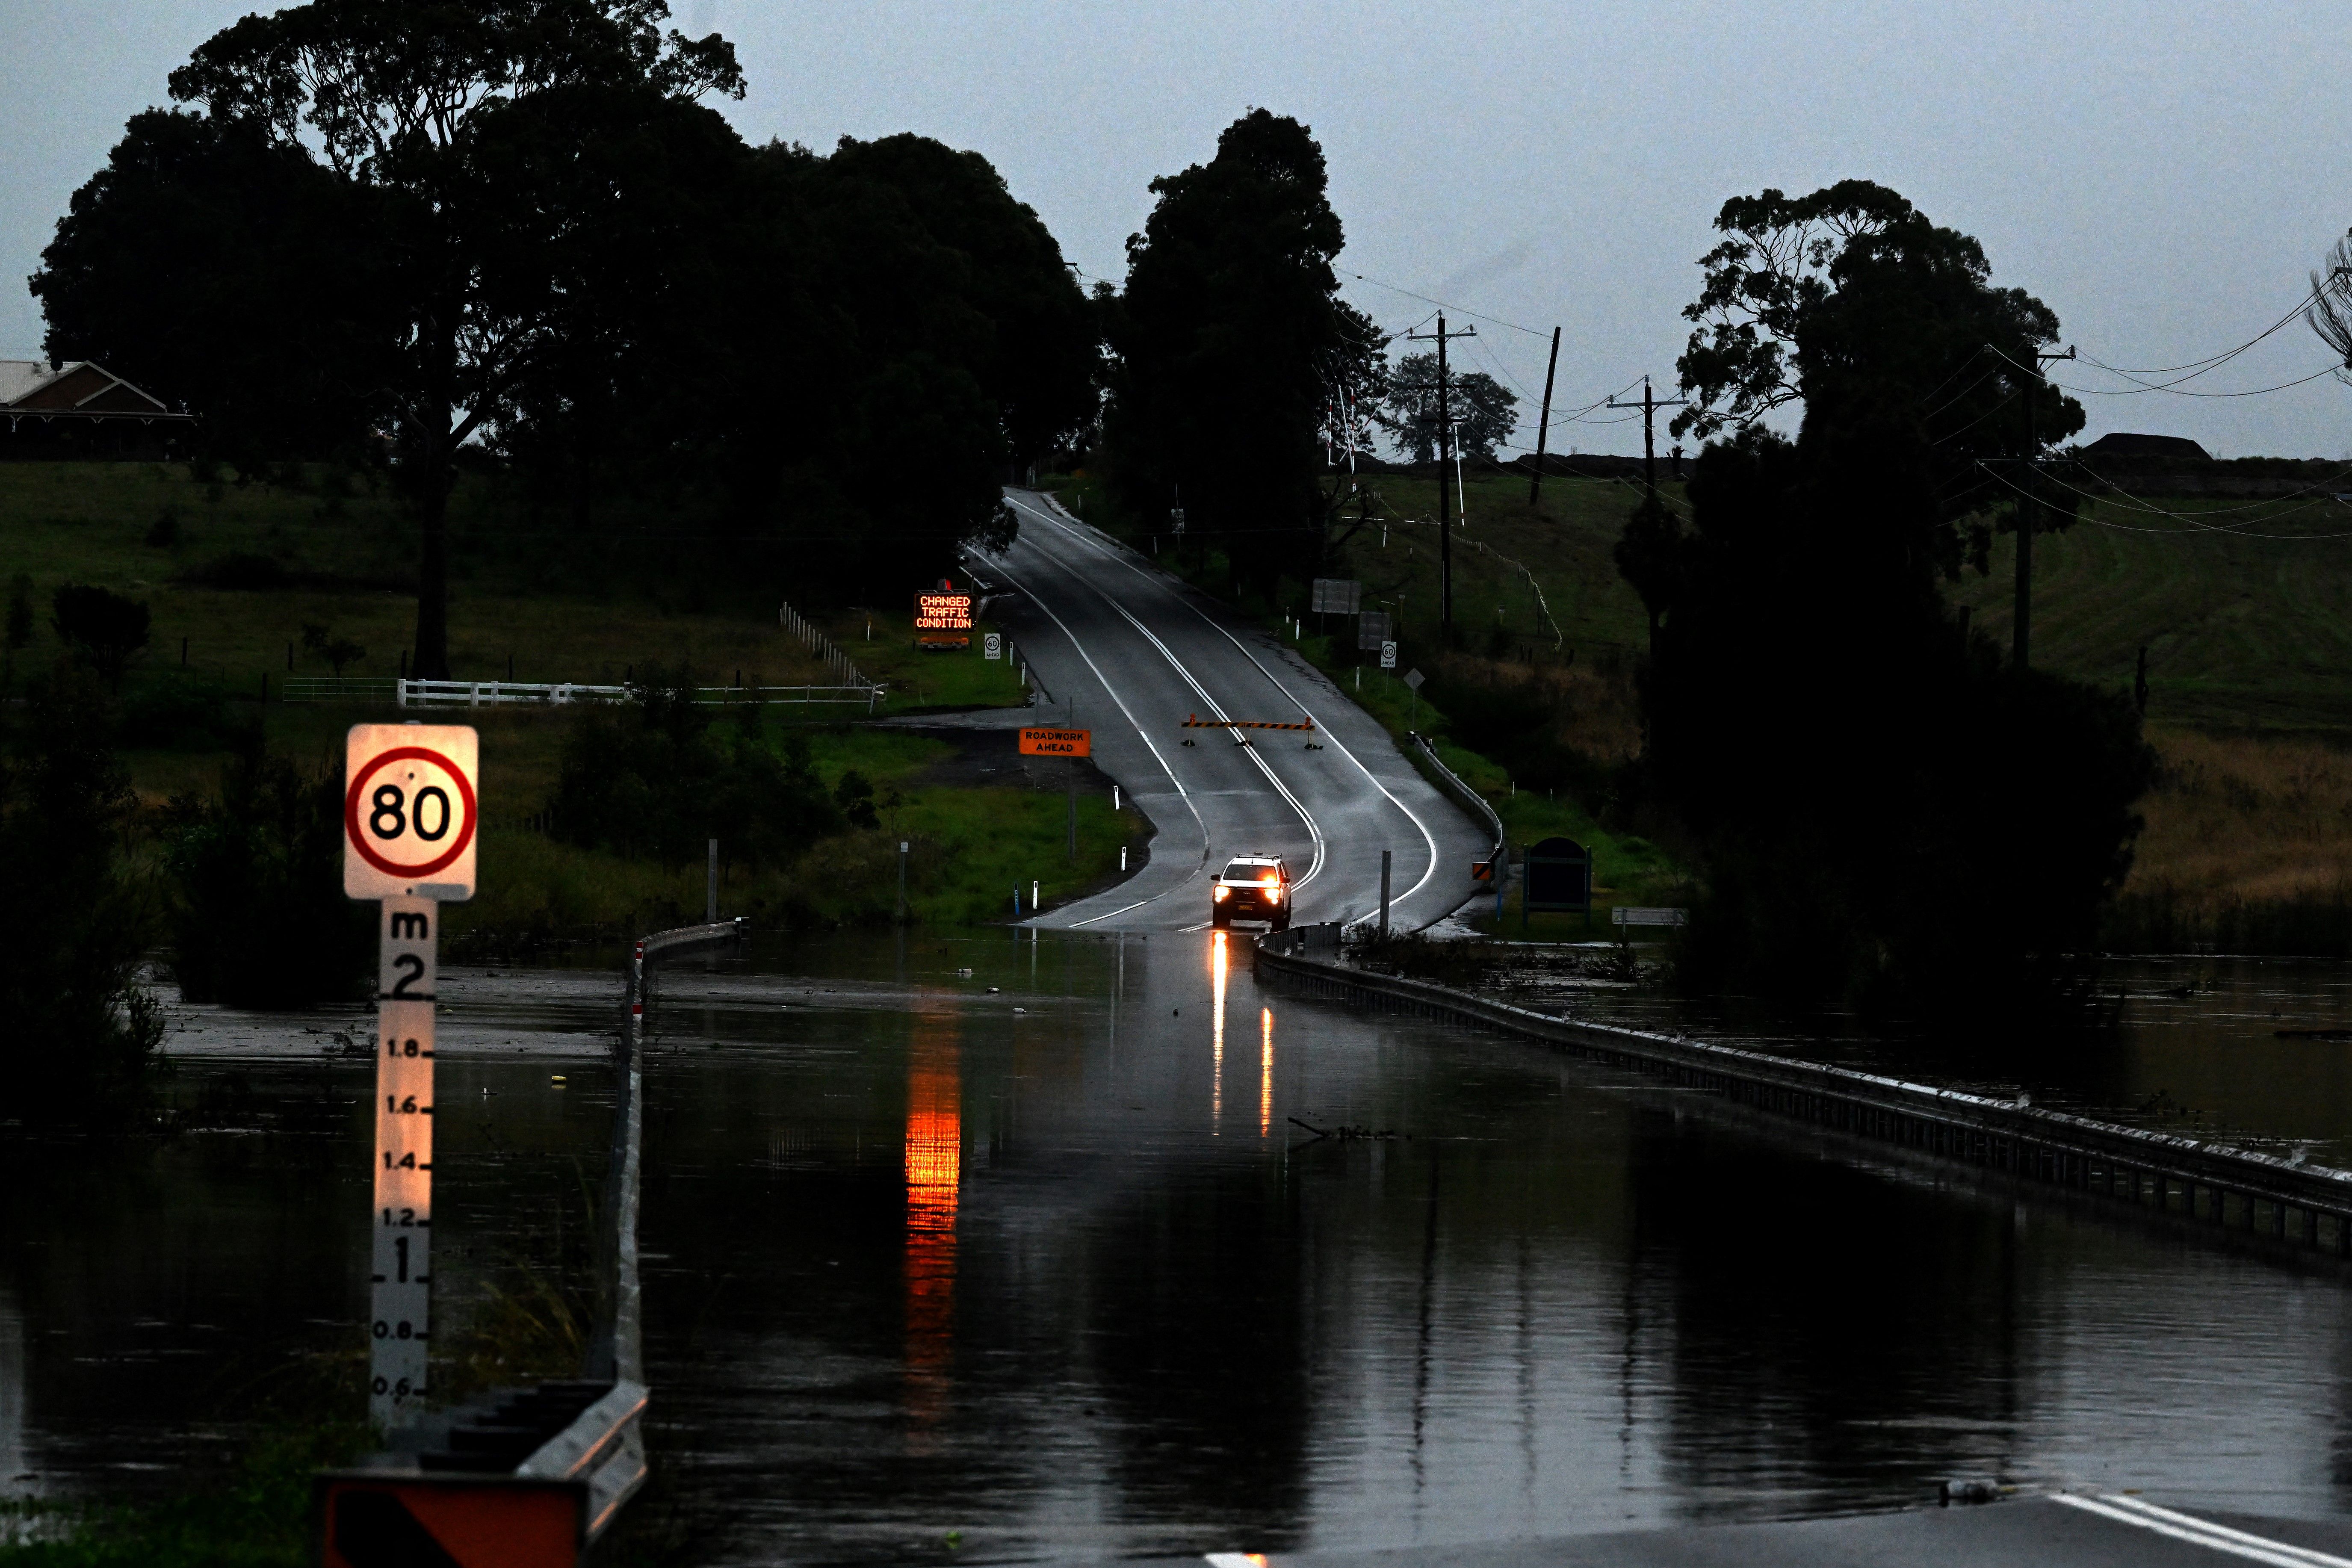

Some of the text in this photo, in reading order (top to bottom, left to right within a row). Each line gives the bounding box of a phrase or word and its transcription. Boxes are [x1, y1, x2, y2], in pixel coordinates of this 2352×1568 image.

[920, 596, 970, 606] CHANGED
[922, 607, 969, 617] TRAFFIC
[916, 618, 971, 628] CONDITION
[1026, 732, 1084, 741] ROADWORK
[1036, 743, 1073, 752] AHEAD
[369, 783, 451, 842] 80
[391, 912, 428, 940] m
[392, 953, 426, 1001] 2
[387, 1039, 419, 1058] 1.8
[387, 1095, 417, 1115] 1.6
[383, 1151, 416, 1170] 1.4
[383, 1208, 414, 1227] 1.2
[396, 1236, 408, 1283] 1
[373, 1320, 411, 1340] 0.8
[372, 1376, 409, 1396] 0.6
